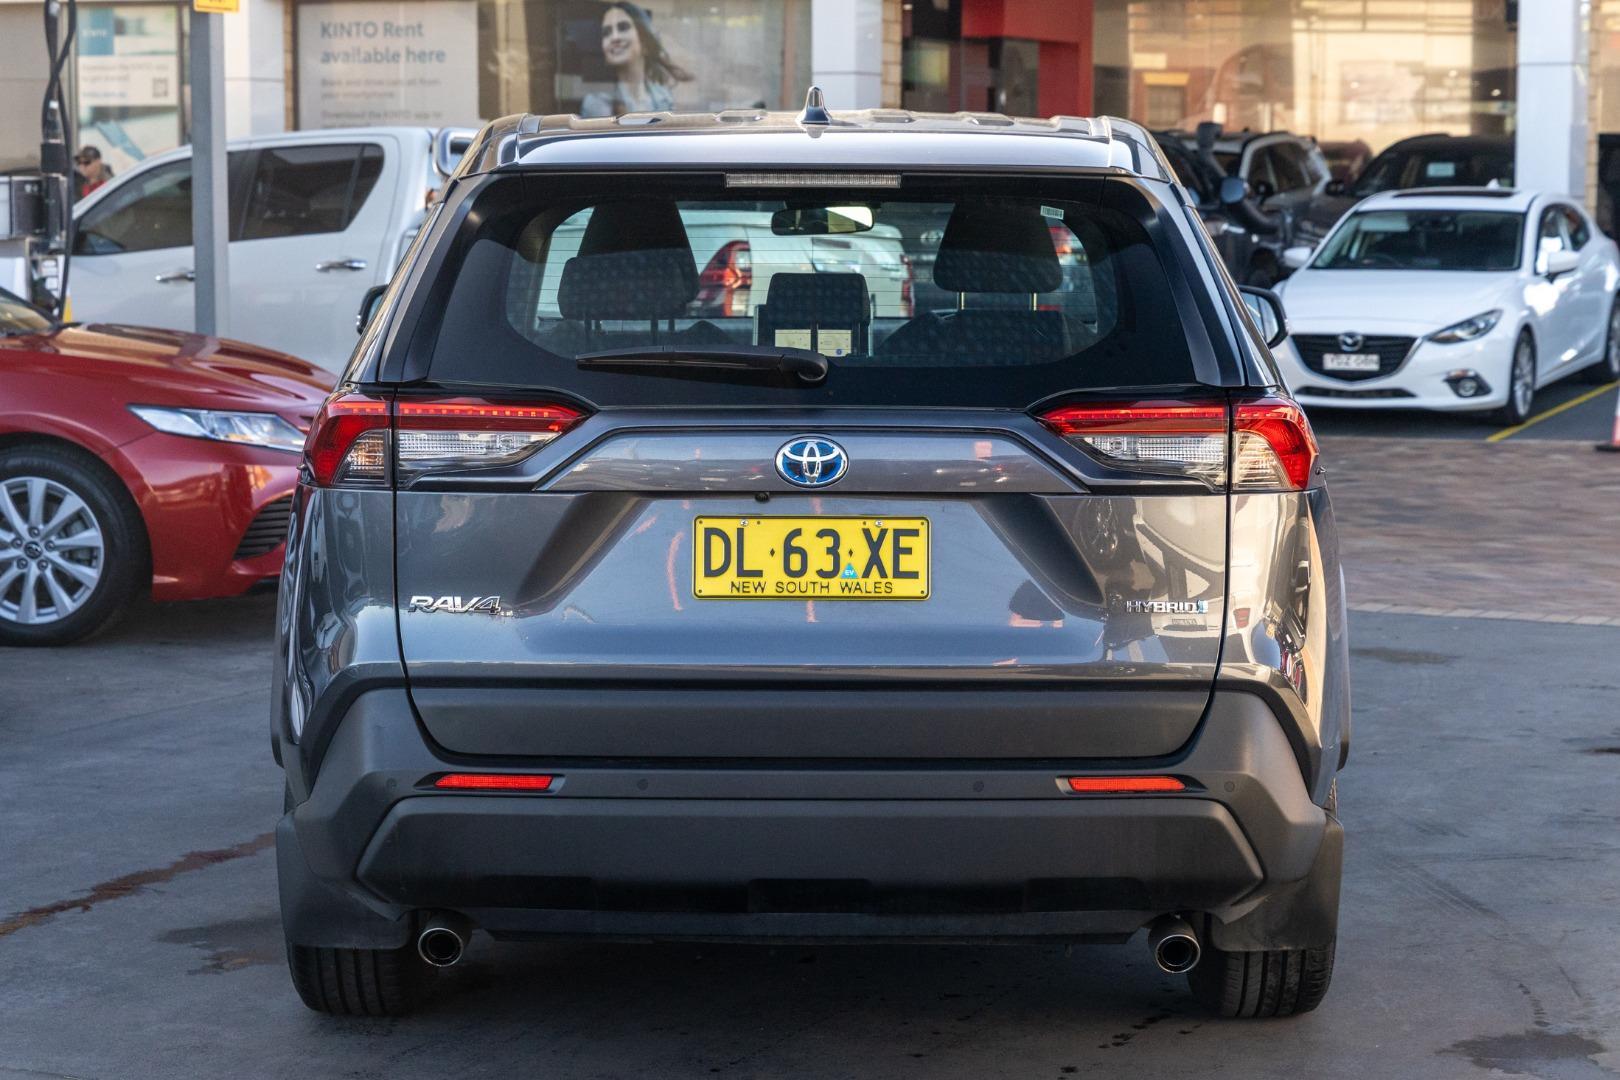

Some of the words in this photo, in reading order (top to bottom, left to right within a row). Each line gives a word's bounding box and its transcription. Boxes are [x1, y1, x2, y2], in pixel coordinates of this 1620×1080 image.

[320, 21, 379, 39] KINTO
[383, 21, 425, 38] Rent
[320, 46, 401, 64] available
[405, 46, 446, 64] here
[730, 581, 767, 594] NEW
[775, 581, 830, 594] SOUTH
[840, 581, 894, 594] WALES
[408, 595, 501, 615] RAV4
[1126, 600, 1198, 613] HYBRID
